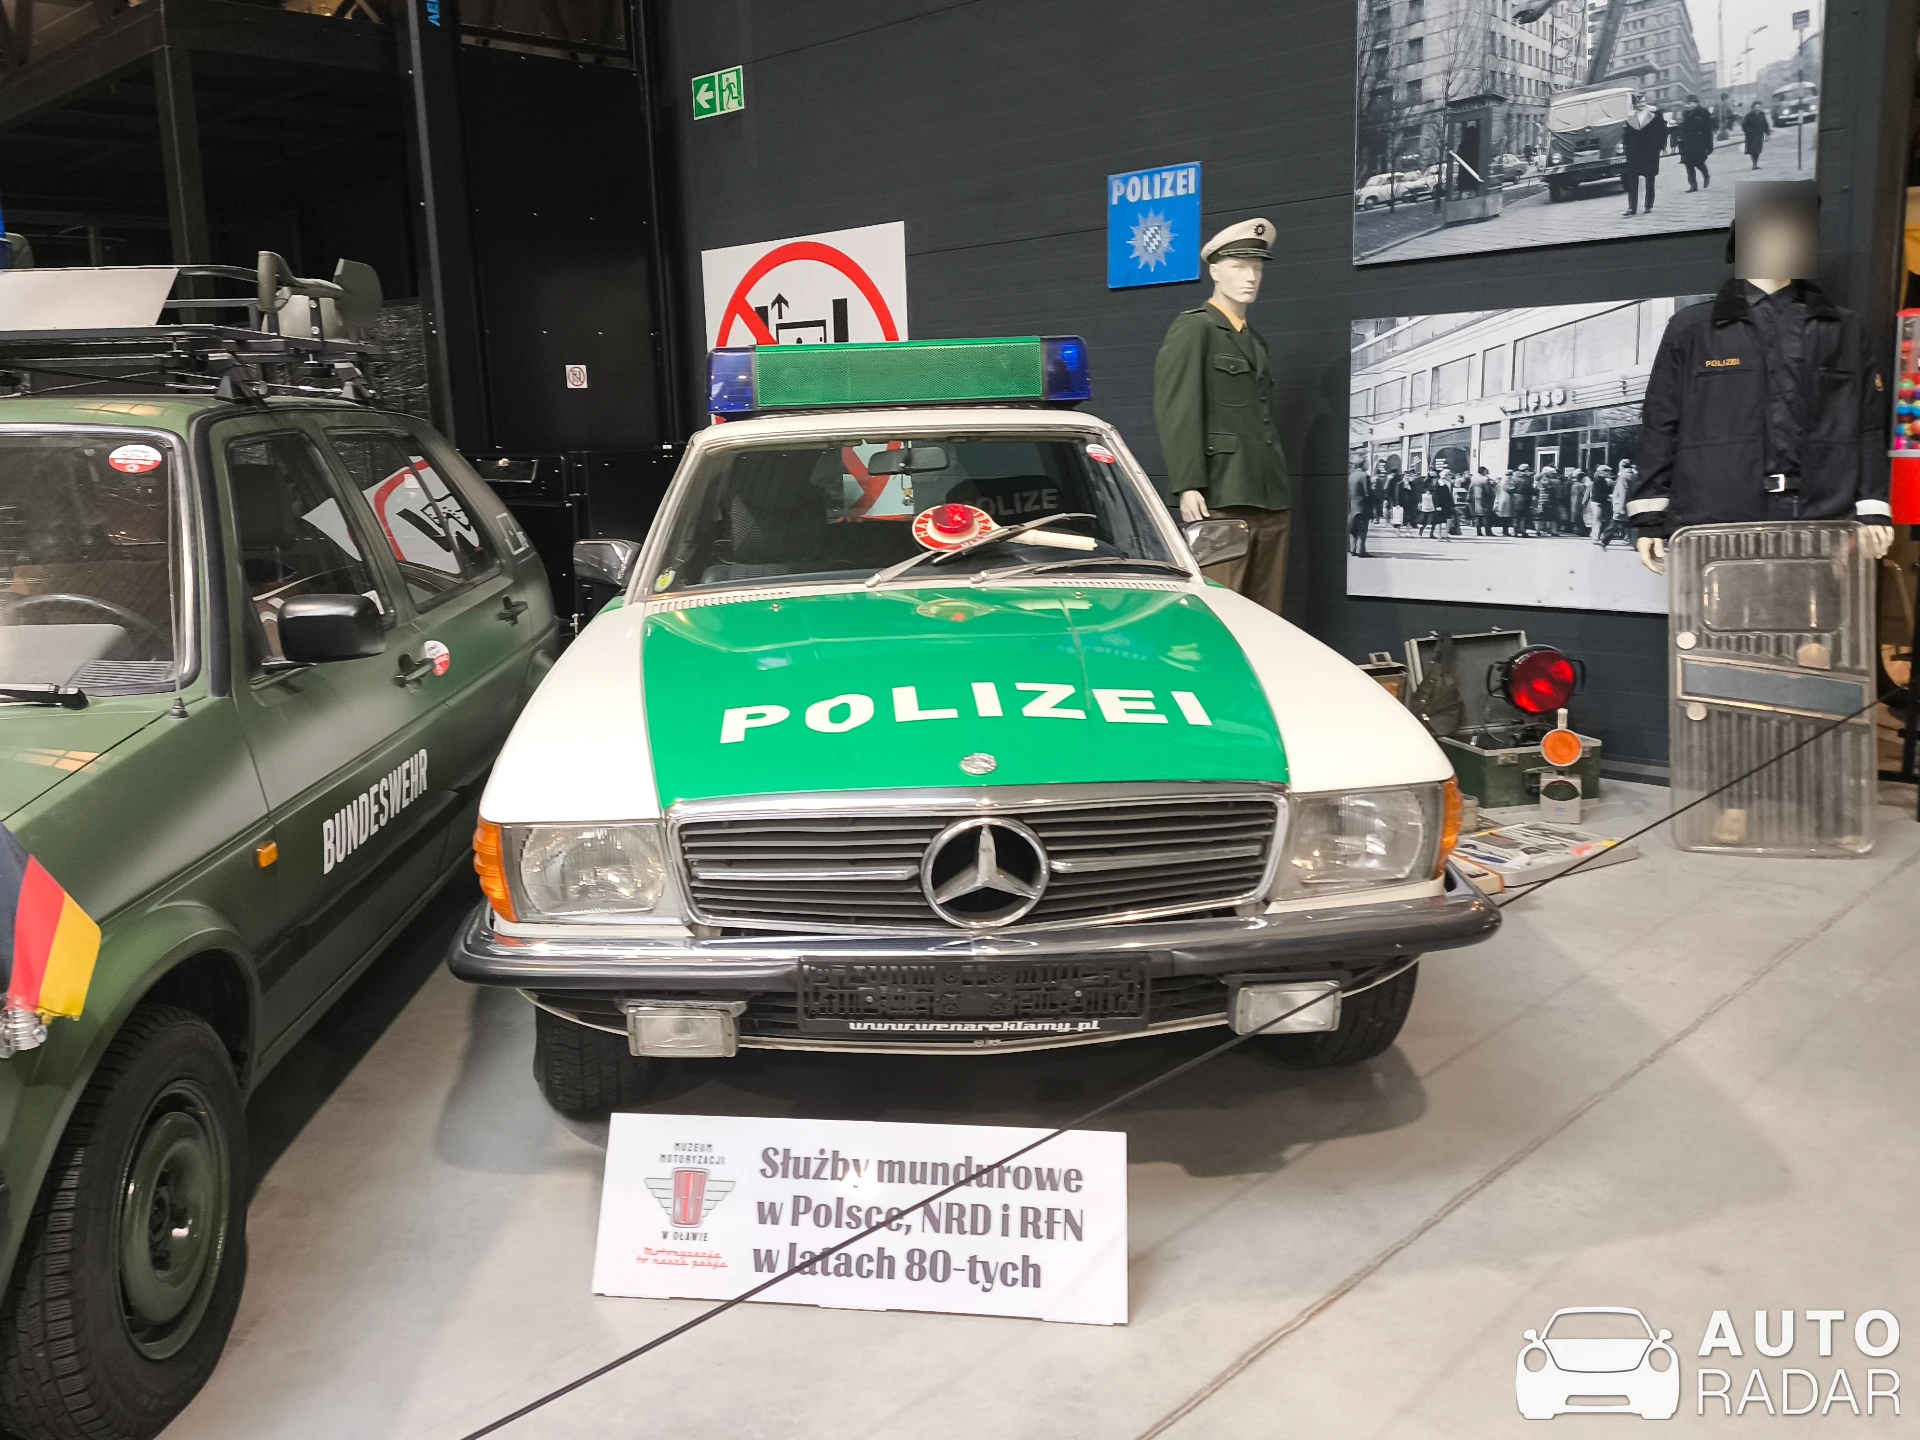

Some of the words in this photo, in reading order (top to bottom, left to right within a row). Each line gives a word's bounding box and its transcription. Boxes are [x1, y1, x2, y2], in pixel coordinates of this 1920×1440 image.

[1111, 167, 1196, 205] POLIZEI
[1705, 358, 1741, 367] POLIZEI
[720, 681, 1213, 744] POLIZEI
[323, 748, 427, 874] BUNDESWEHR
[660, 1154, 725, 1165] MOTORYZACJI
[674, 1142, 713, 1152] MUZEUM
[759, 1147, 869, 1186] Służby
[877, 1156, 1083, 1193] mundurowe
[662, 1230, 669, 1240] W
[673, 1231, 708, 1241] OŁAWIE
[757, 1201, 784, 1226] w
[791, 1195, 912, 1236] Polsce,
[922, 1201, 991, 1236] NRD
[1001, 1203, 1011, 1238] i
[1020, 1205, 1084, 1242] RFN
[752, 1247, 781, 1274] w
[788, 1242, 896, 1279] latach
[905, 1247, 1042, 1293] 80-tych
